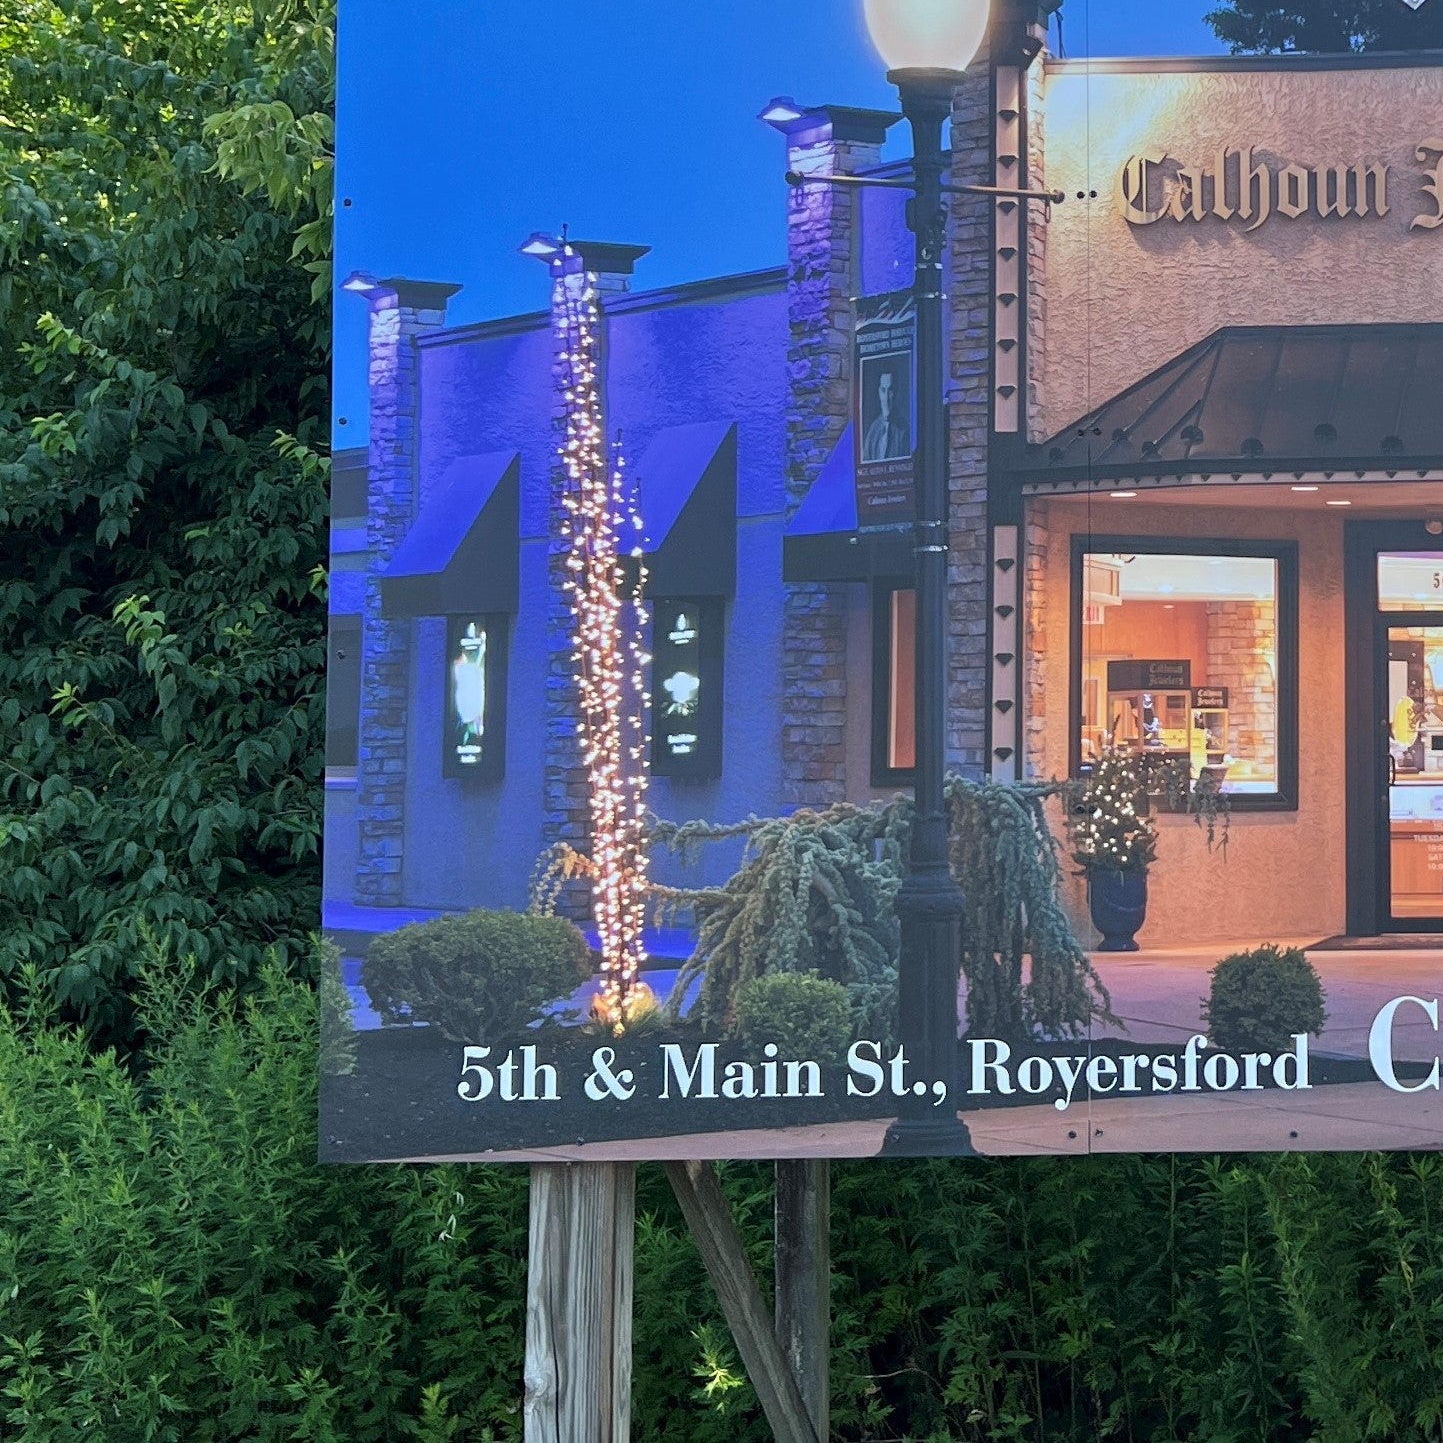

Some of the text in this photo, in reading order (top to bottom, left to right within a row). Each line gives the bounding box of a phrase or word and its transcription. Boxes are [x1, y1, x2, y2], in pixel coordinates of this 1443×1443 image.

[1118, 144, 1391, 232] Calhoun
[457, 1032, 1313, 1111] 5th & Main St., Royersford
